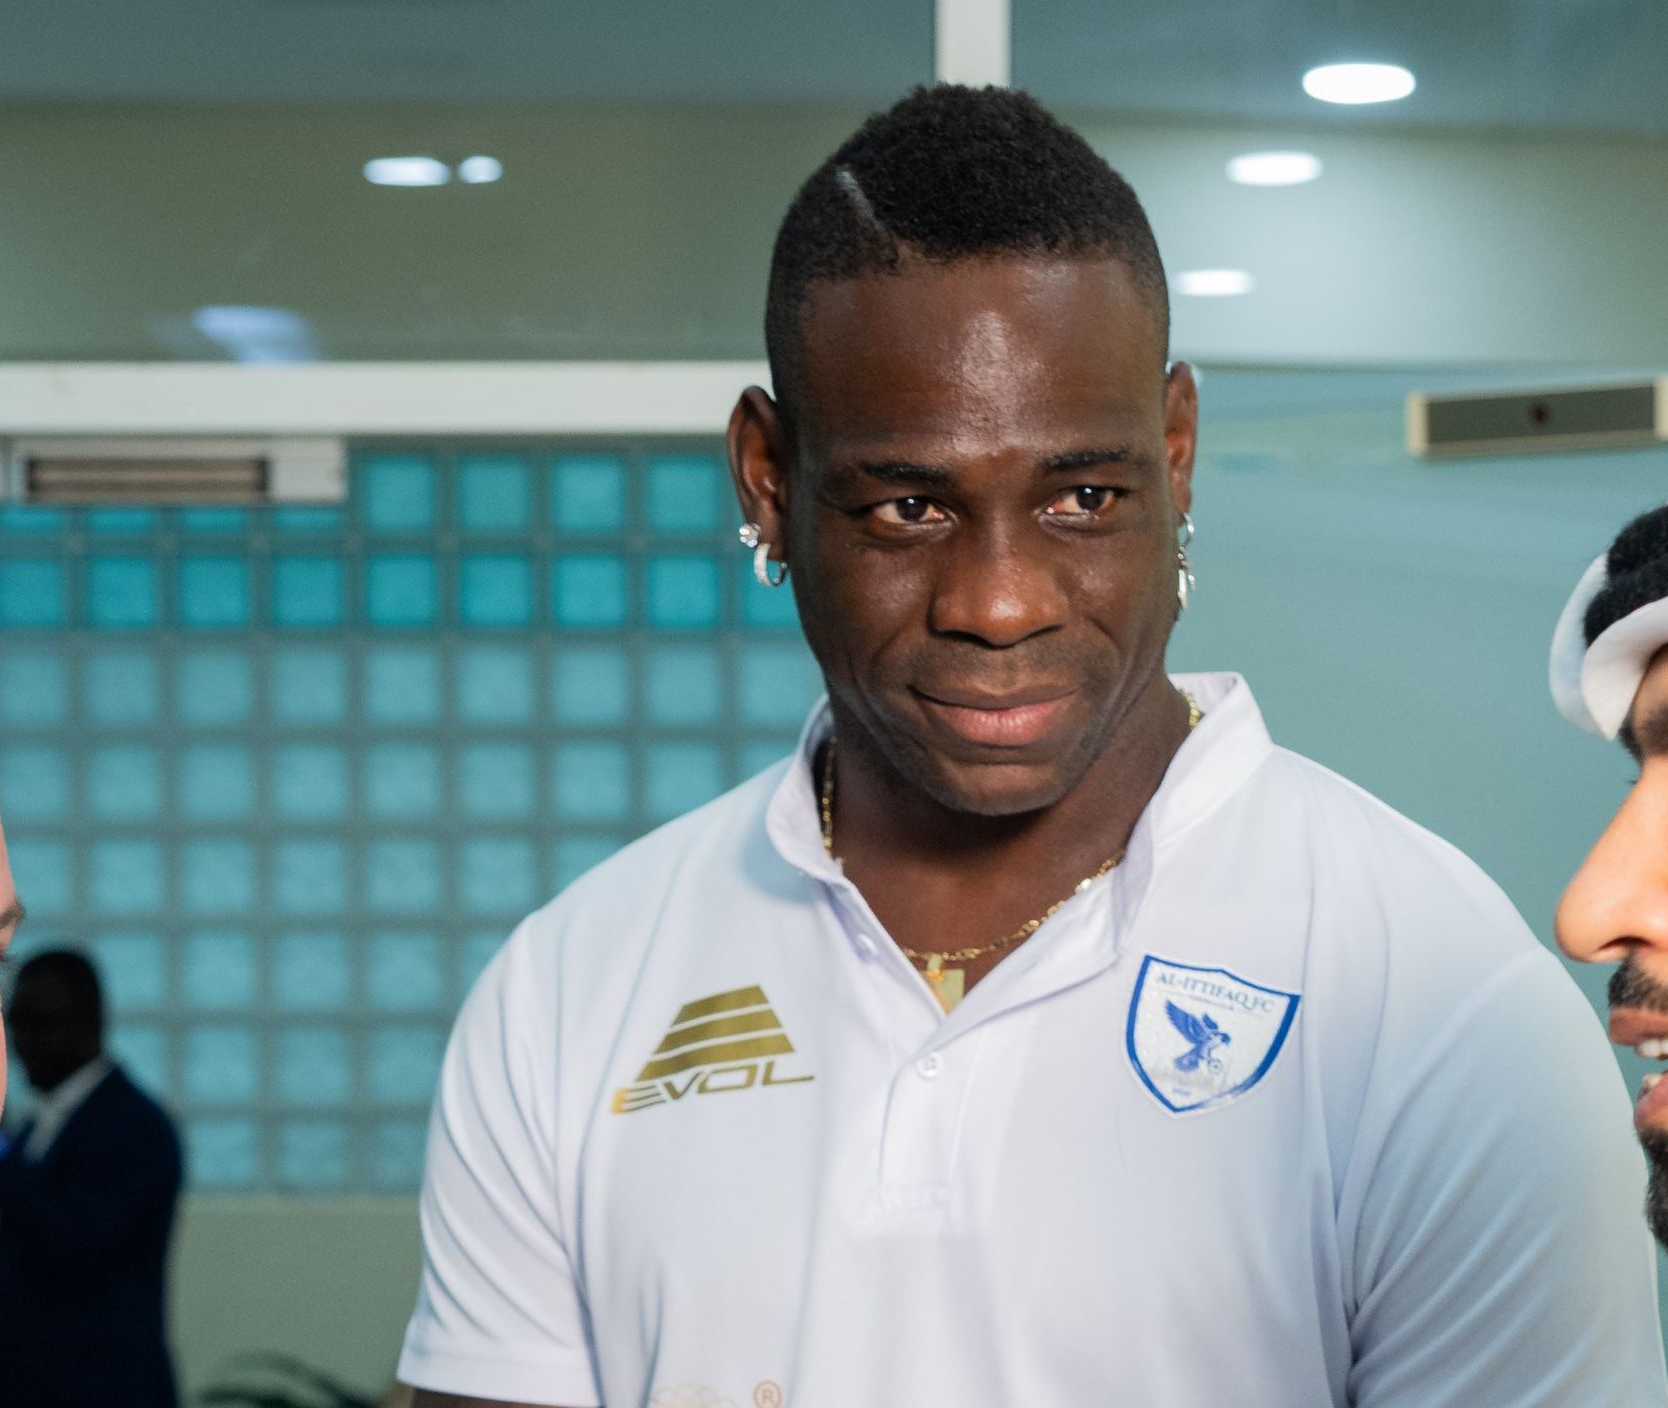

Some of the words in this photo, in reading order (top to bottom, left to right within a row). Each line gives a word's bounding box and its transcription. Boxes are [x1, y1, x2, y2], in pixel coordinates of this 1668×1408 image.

[1156, 972, 1253, 1012] AL-ITTIFAQ
[1250, 997, 1276, 1014] FC
[610, 1060, 815, 1115] EVOL
